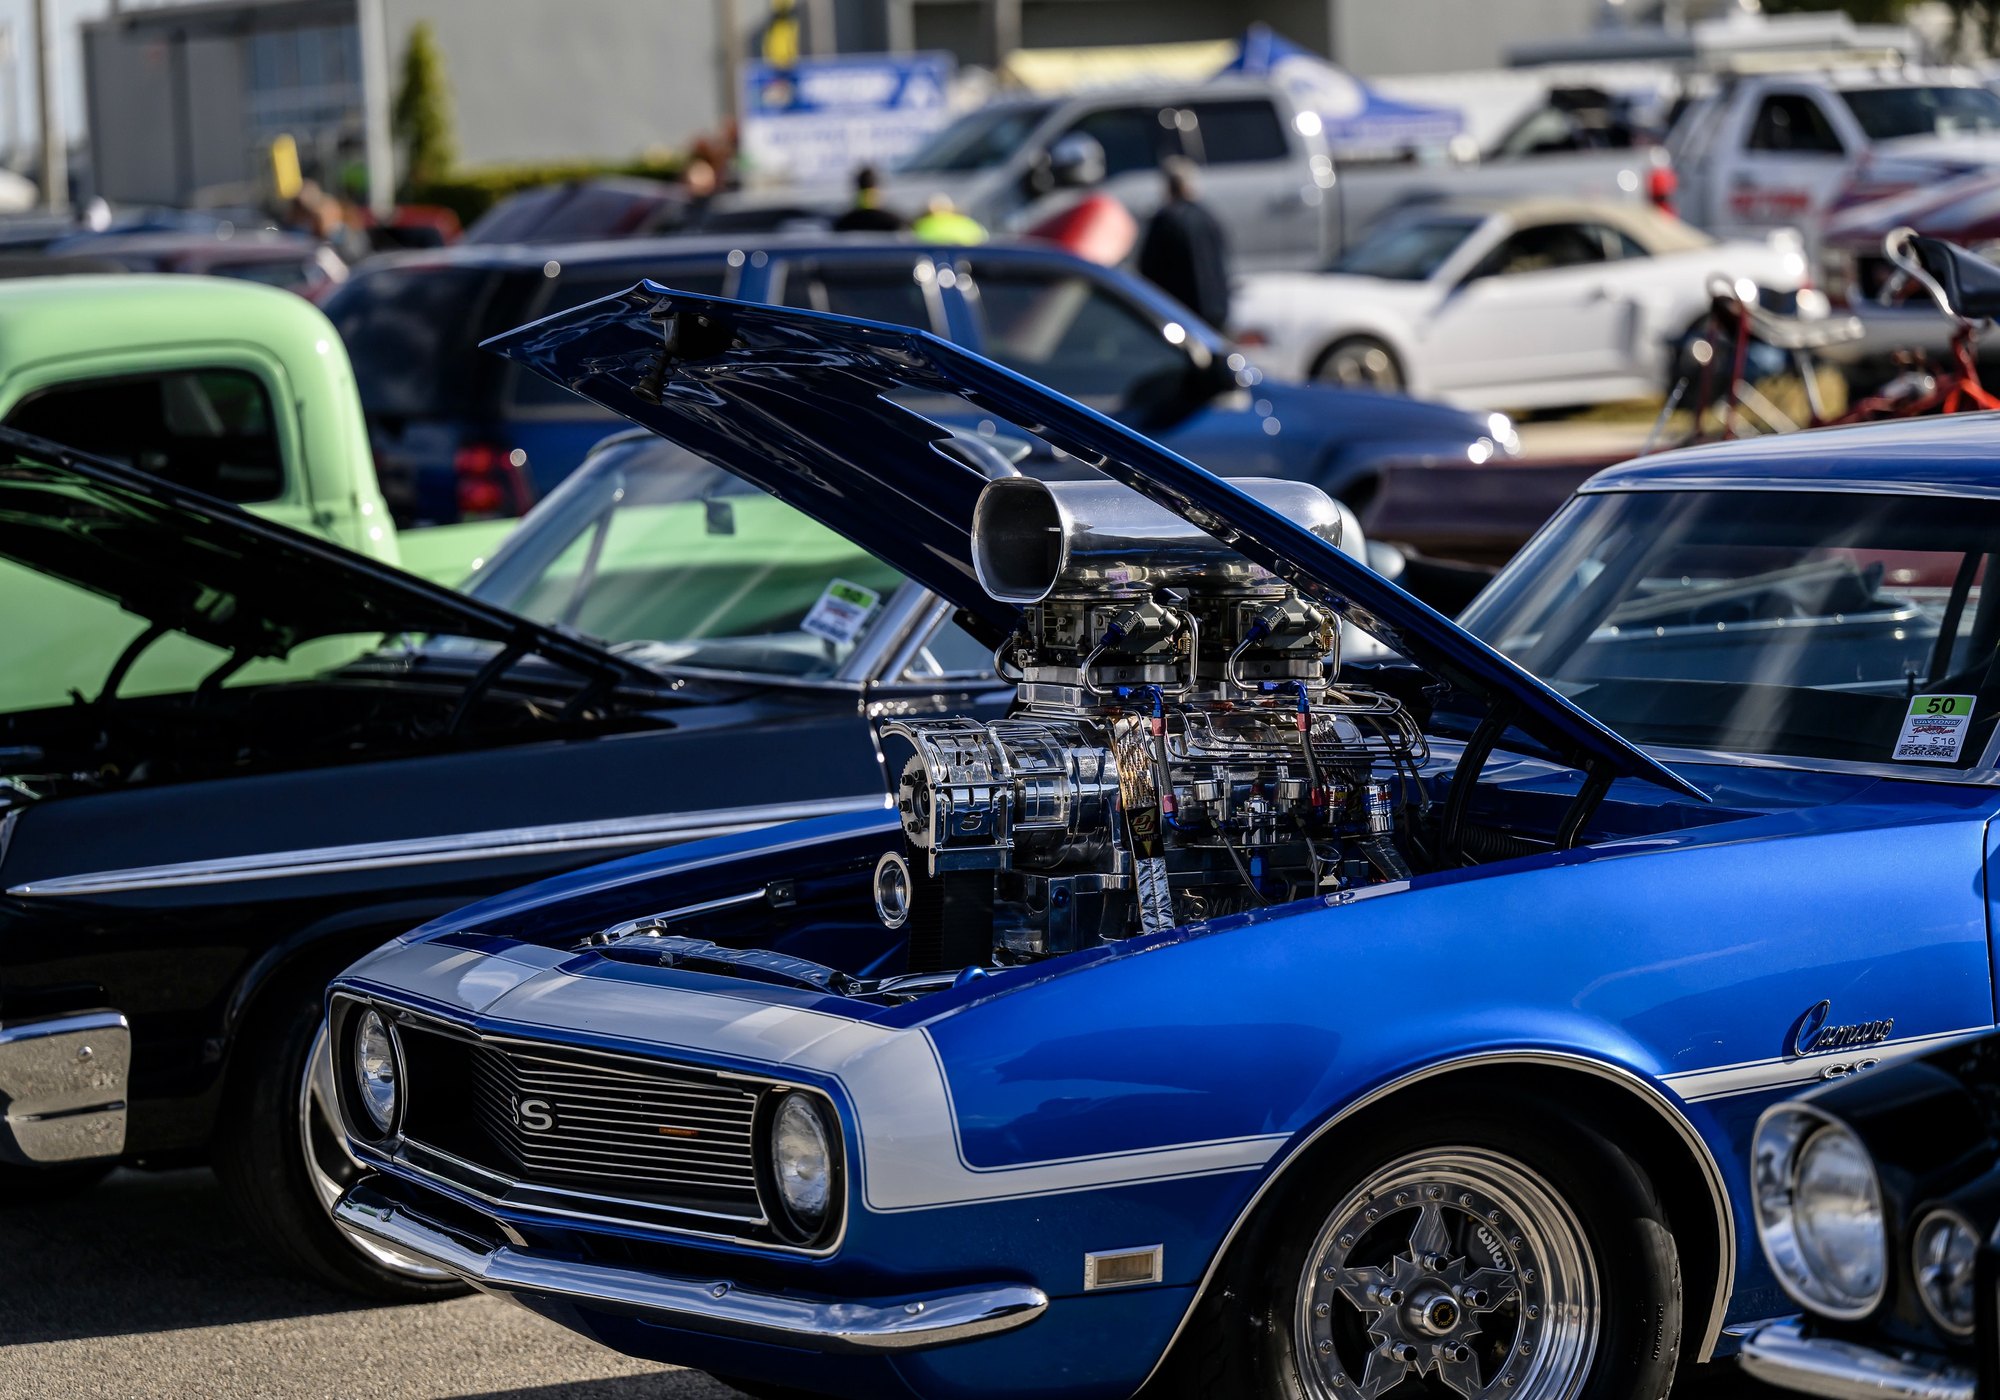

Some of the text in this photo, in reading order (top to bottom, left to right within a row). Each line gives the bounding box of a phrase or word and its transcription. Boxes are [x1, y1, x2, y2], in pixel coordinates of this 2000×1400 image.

[1123, 613, 1141, 632] Holley
[1926, 697, 1956, 714] 50
[1795, 999, 1894, 1056] Camaro
[511, 1095, 553, 1131] SS
